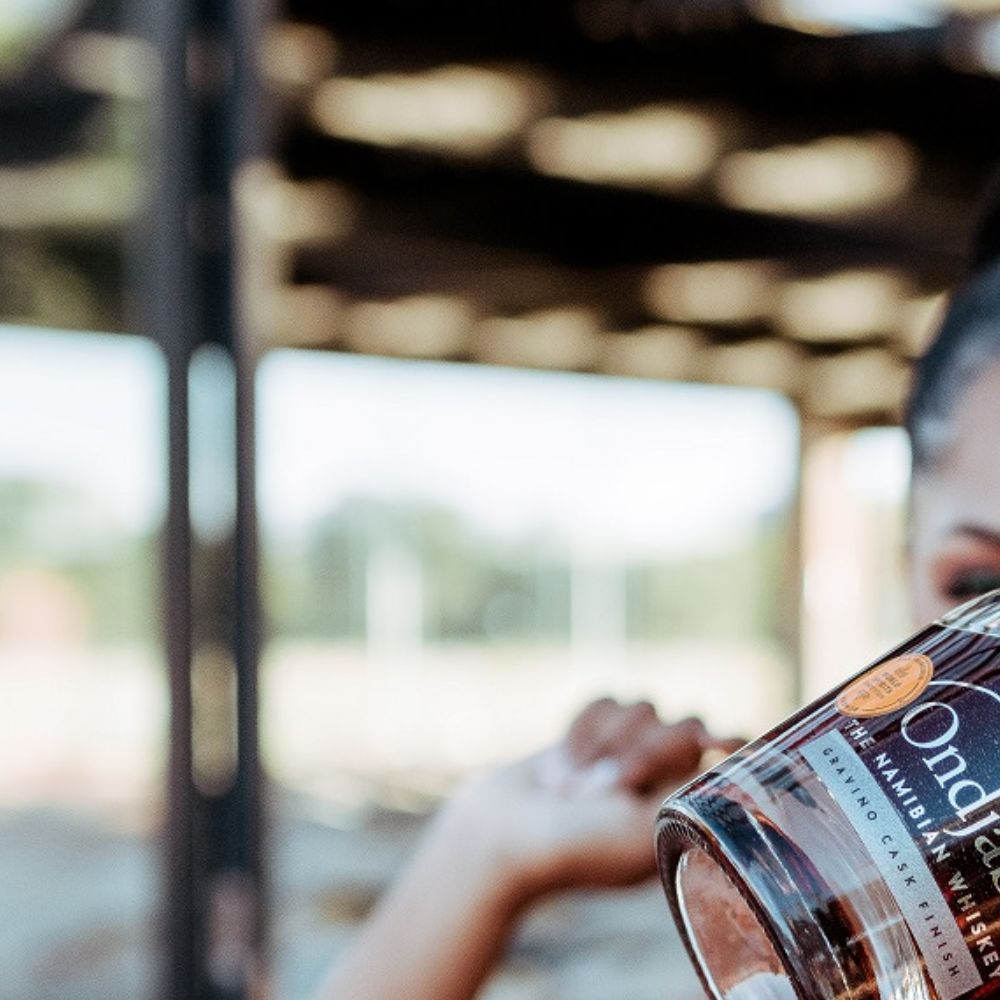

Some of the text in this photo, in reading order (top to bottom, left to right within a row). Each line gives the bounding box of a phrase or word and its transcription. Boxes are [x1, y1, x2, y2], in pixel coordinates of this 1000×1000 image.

[822, 747, 961, 978] GRAVINO CASK FINISH
[844, 718, 875, 750] THE
[874, 752, 951, 863] NAMIBIAN
